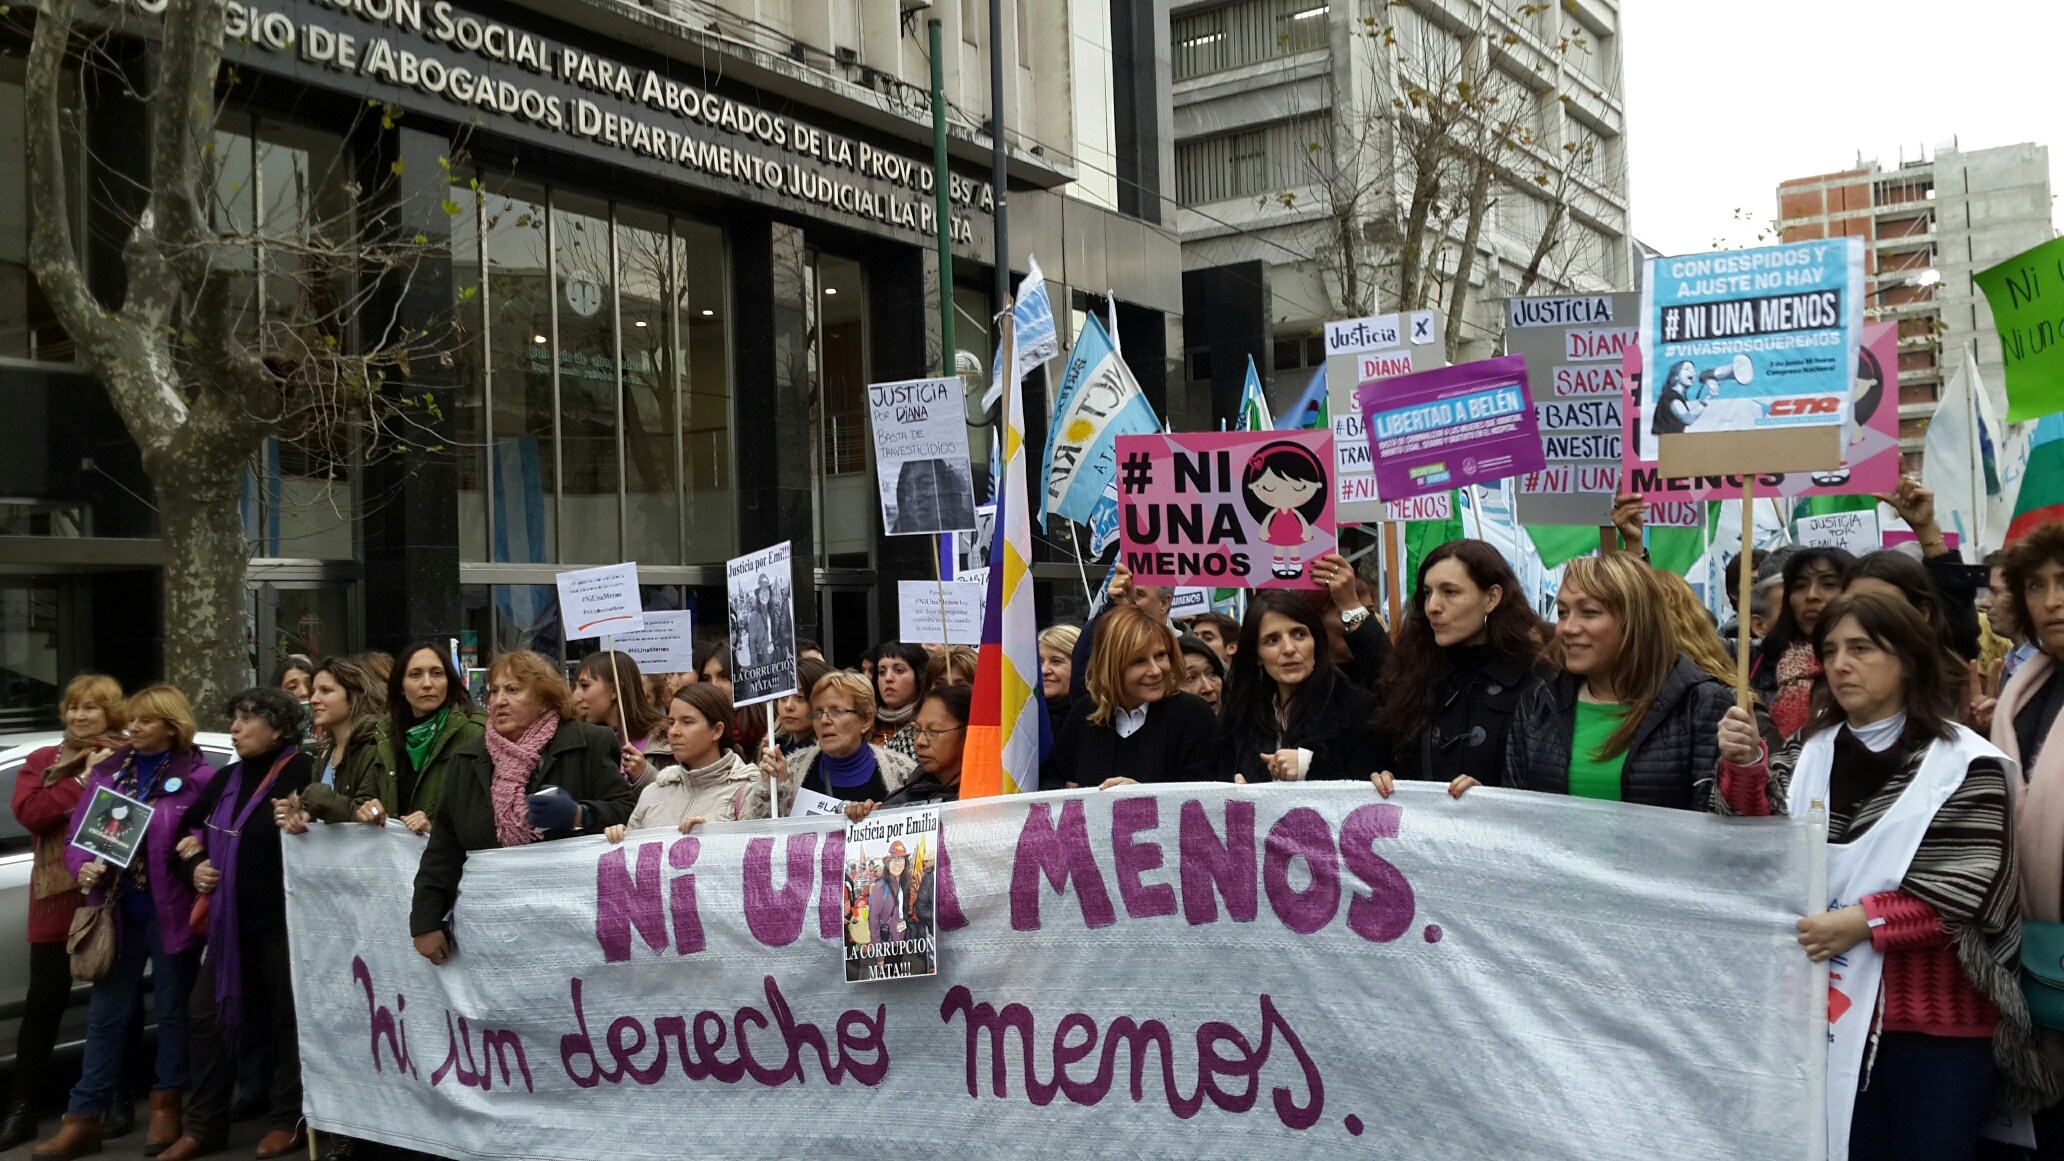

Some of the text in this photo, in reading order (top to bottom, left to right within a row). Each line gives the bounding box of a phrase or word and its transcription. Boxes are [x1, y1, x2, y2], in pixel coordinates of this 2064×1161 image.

[434, 1, 552, 73] SOCIAL
[563, 47, 635, 98] PARA
[642, 69, 787, 145] ABOGADOS
[794, 123, 820, 156] DE
[828, 134, 853, 166] LA
[859, 141, 914, 187] PROV.
[920, 166, 934, 191] D
[307, 24, 356, 70] DE
[789, 163, 884, 219] JUDICIAL
[890, 194, 915, 227] LA
[921, 202, 973, 242] PLTA
[1671, 246, 1828, 279] CON DESPIDOS Y
[1677, 267, 1825, 298] AJUSTE NO HAY
[1684, 303, 1706, 338] NI
[1711, 299, 1755, 337] UNA
[1759, 292, 1836, 332] MENOS
[1664, 331, 1841, 358] #VIVASNOSQUEREMOS
[1376, 404, 1453, 439] LIBERTAD
[1455, 400, 1468, 422] A
[1468, 389, 1520, 419] BELÉN
[877, 429, 925, 446] BASTA DE
[1173, 450, 1231, 493] NI
[1389, 495, 1448, 518] MENOS
[1125, 503, 1248, 545] UNA
[728, 559, 754, 578] Justicia
[755, 557, 767, 573] por
[1127, 552, 1251, 577] MENOS
[732, 669, 745, 684] LA
[847, 812, 938, 844] Justicia por Emilia
[1010, 795, 1443, 943] MENOS.
[844, 936, 935, 961] LA CORRUPCION
[868, 961, 912, 981] MATA!!!
[431, 1009, 534, 1094] un
[560, 975, 892, 1089] derecho
